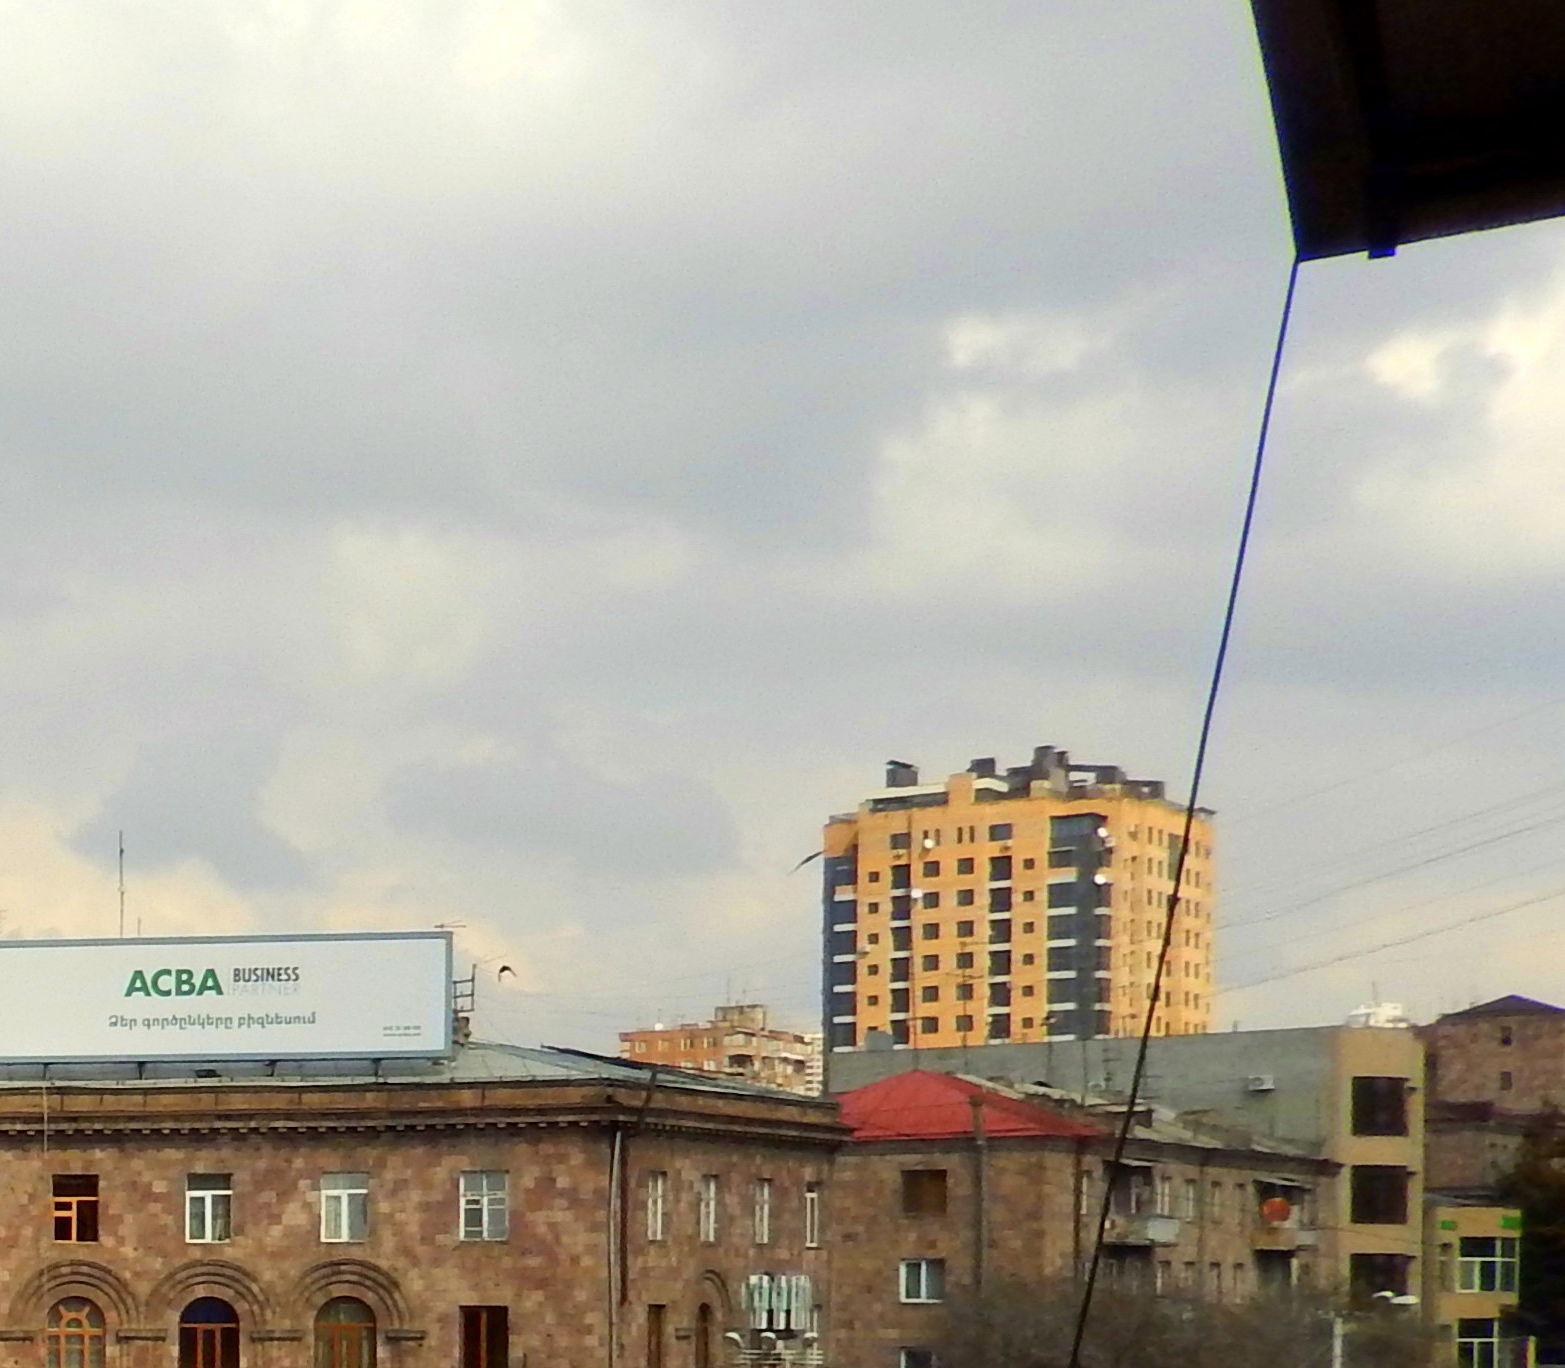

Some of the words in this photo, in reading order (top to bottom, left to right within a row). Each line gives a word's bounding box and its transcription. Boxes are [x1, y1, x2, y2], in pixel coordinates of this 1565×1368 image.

[124, 968, 224, 997] ACBA
[233, 966, 300, 983] BUSINESS
[108, 1016, 136, 1030] Ձեր
[142, 1013, 234, 1030] գործընկերը
[237, 1011, 317, 1029] բիզնեսում
